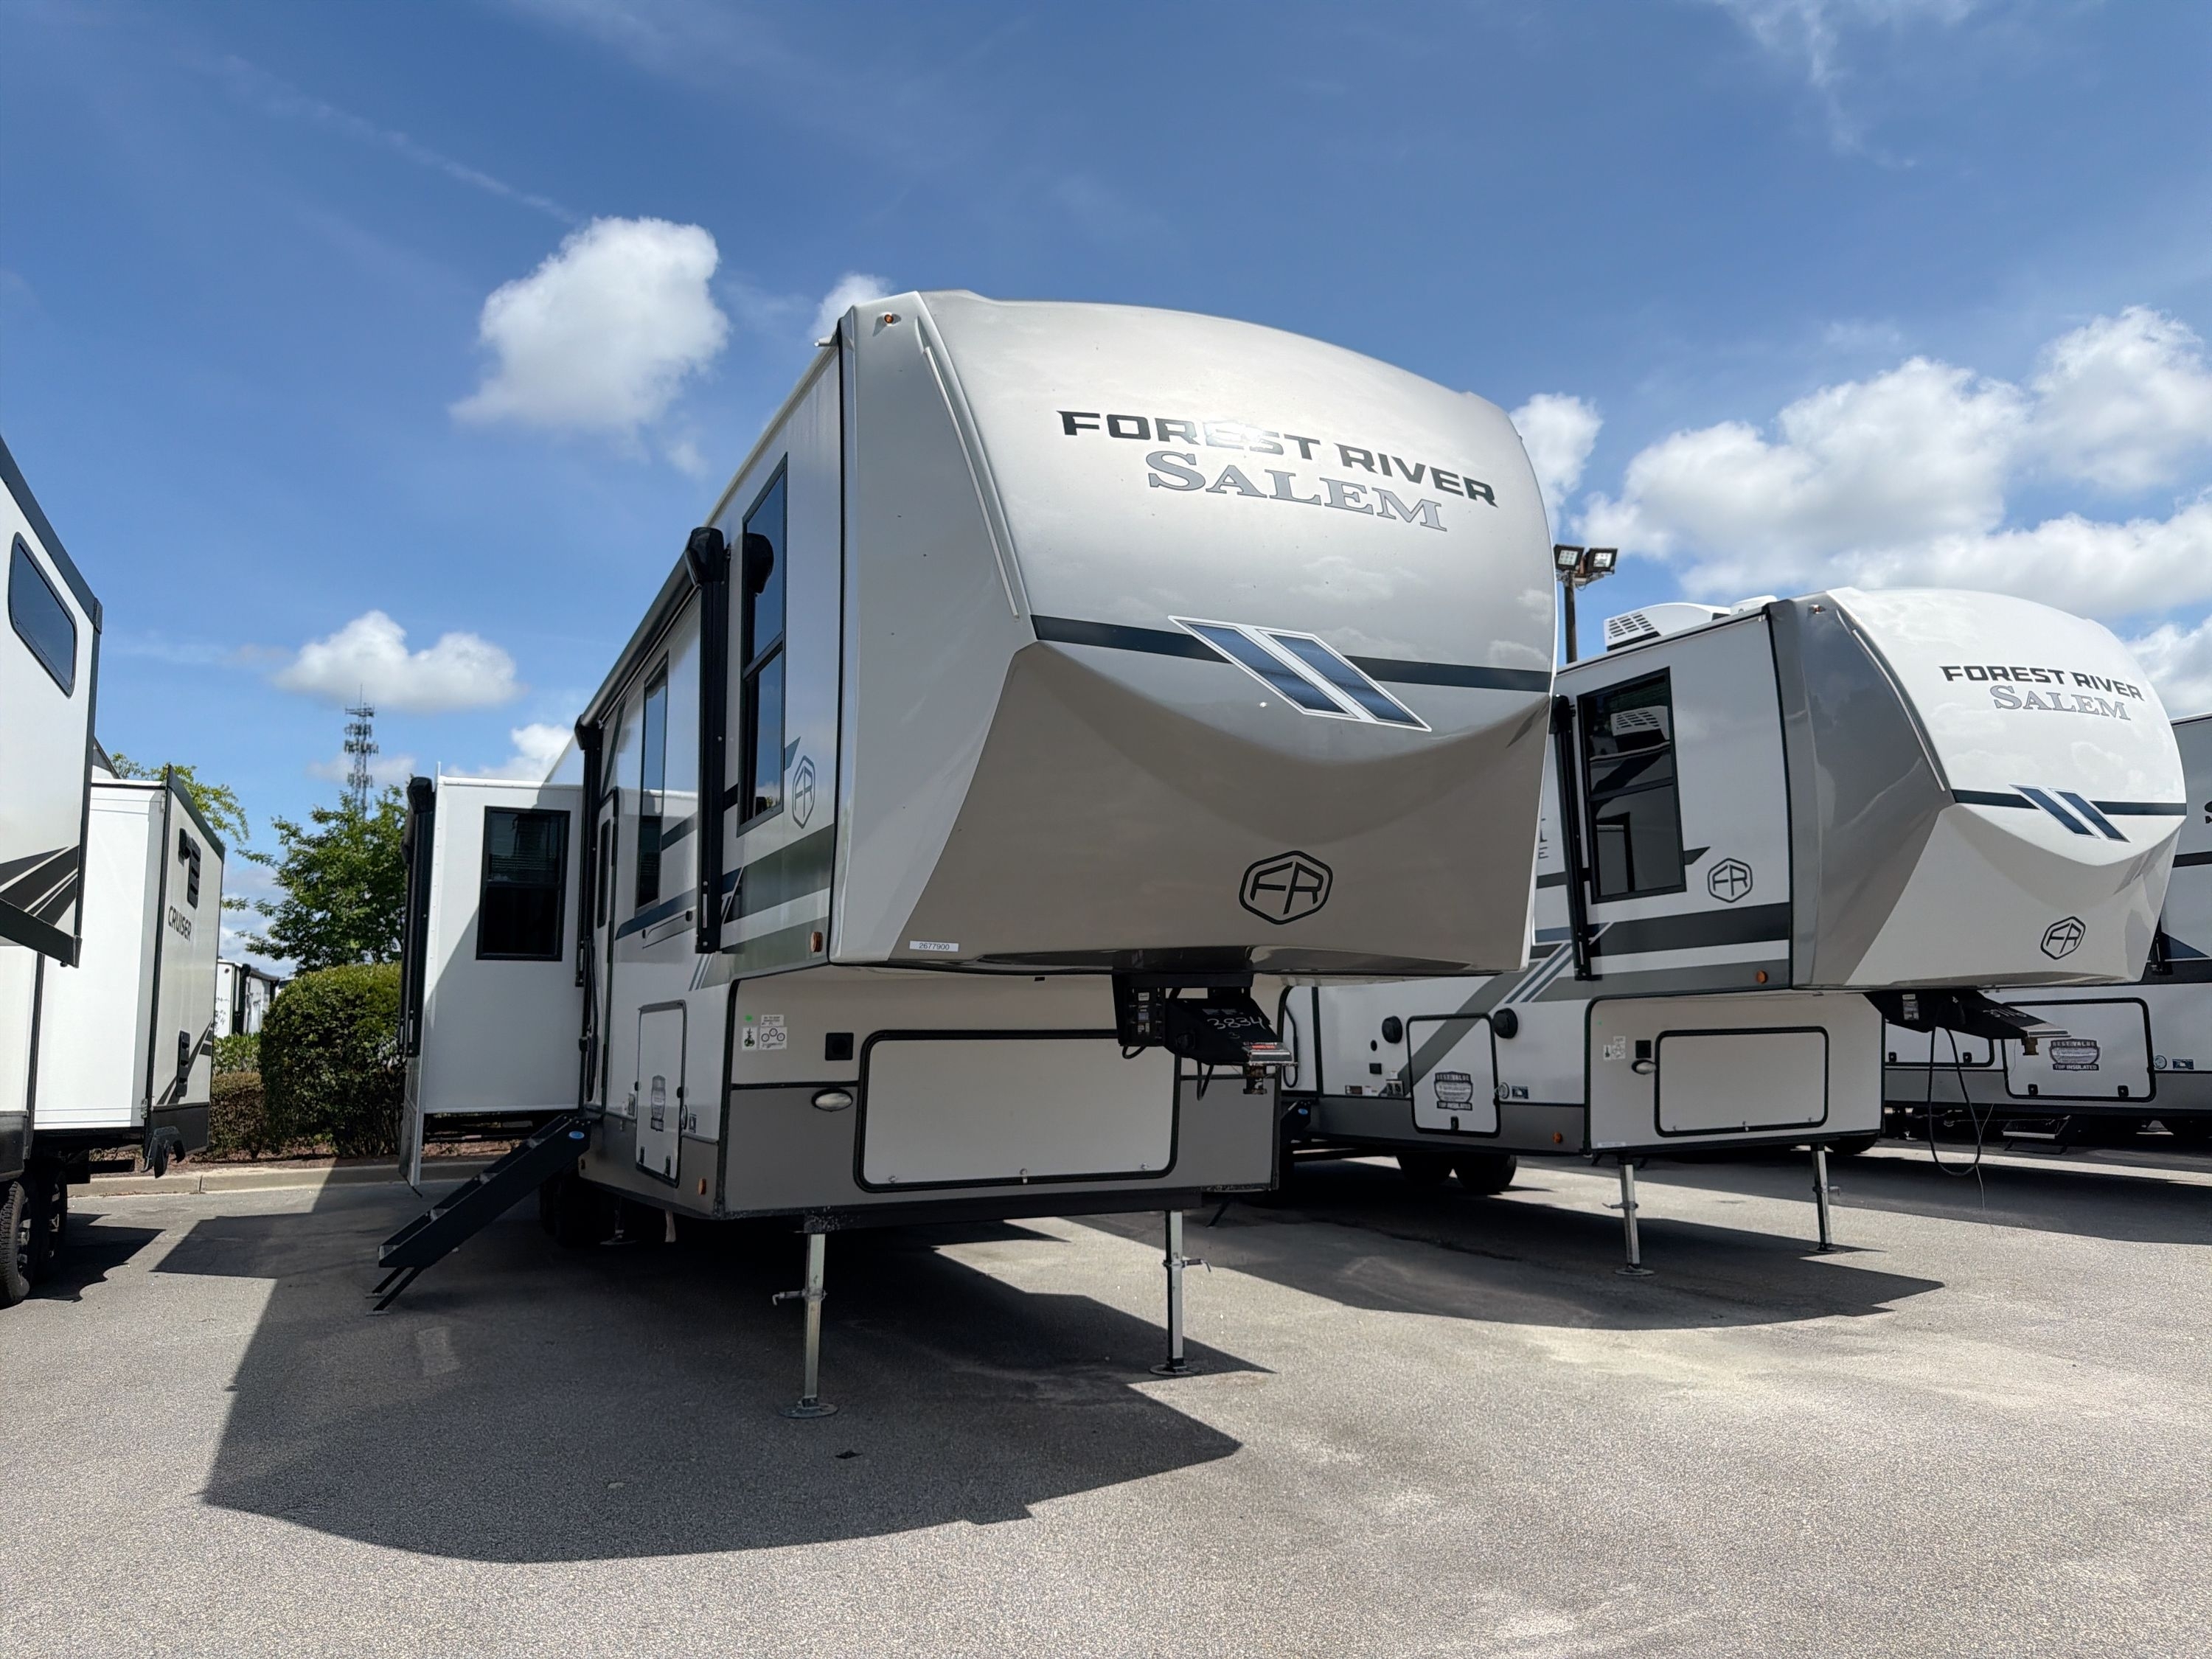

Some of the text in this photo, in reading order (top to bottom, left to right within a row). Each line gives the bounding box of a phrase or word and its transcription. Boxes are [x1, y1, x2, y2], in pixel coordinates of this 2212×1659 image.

[1056, 410, 1499, 509] FOREST RIVER
[1145, 450, 1448, 532] SALEM
[1938, 664, 2146, 701] FOREST RIVER
[1989, 684, 2132, 721] SALEM
[167, 905, 192, 942] CRUISER
[918, 942, 950, 950] 2677900
[1206, 1015, 1267, 1030] 3834
